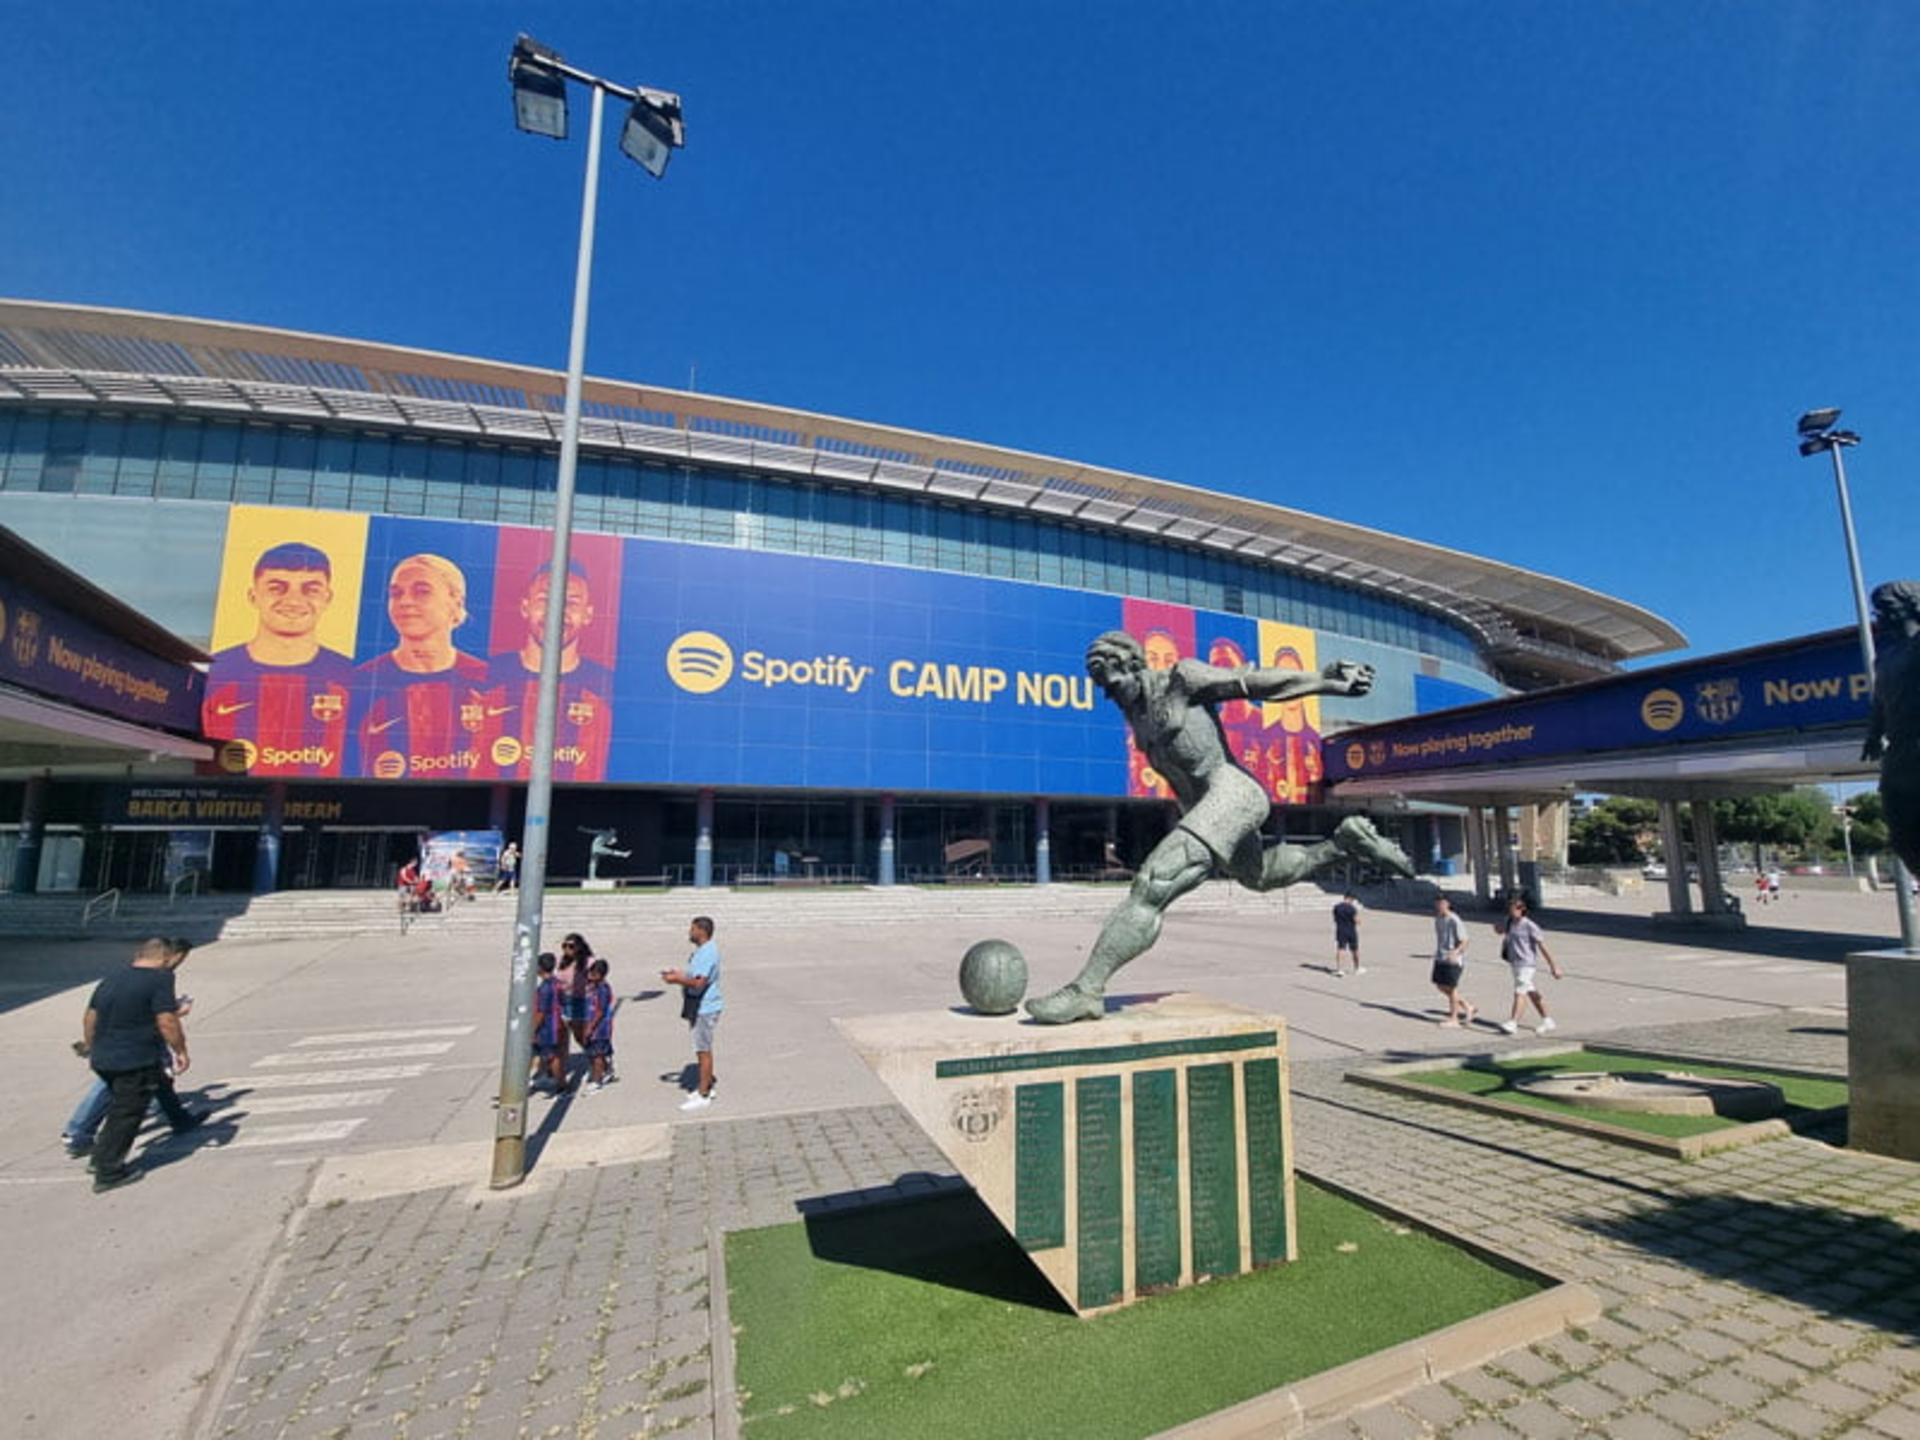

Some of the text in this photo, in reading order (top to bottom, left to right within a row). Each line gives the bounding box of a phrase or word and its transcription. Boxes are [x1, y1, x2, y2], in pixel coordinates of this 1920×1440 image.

[742, 651, 1093, 711] Spotify CAMP NOU
[1763, 678, 1840, 706] Now
[1469, 725, 1534, 748] together
[262, 746, 334, 767] Spotify
[410, 751, 481, 771] Spotify
[524, 746, 586, 765] Stify
[196, 802, 264, 817] VIRTUA
